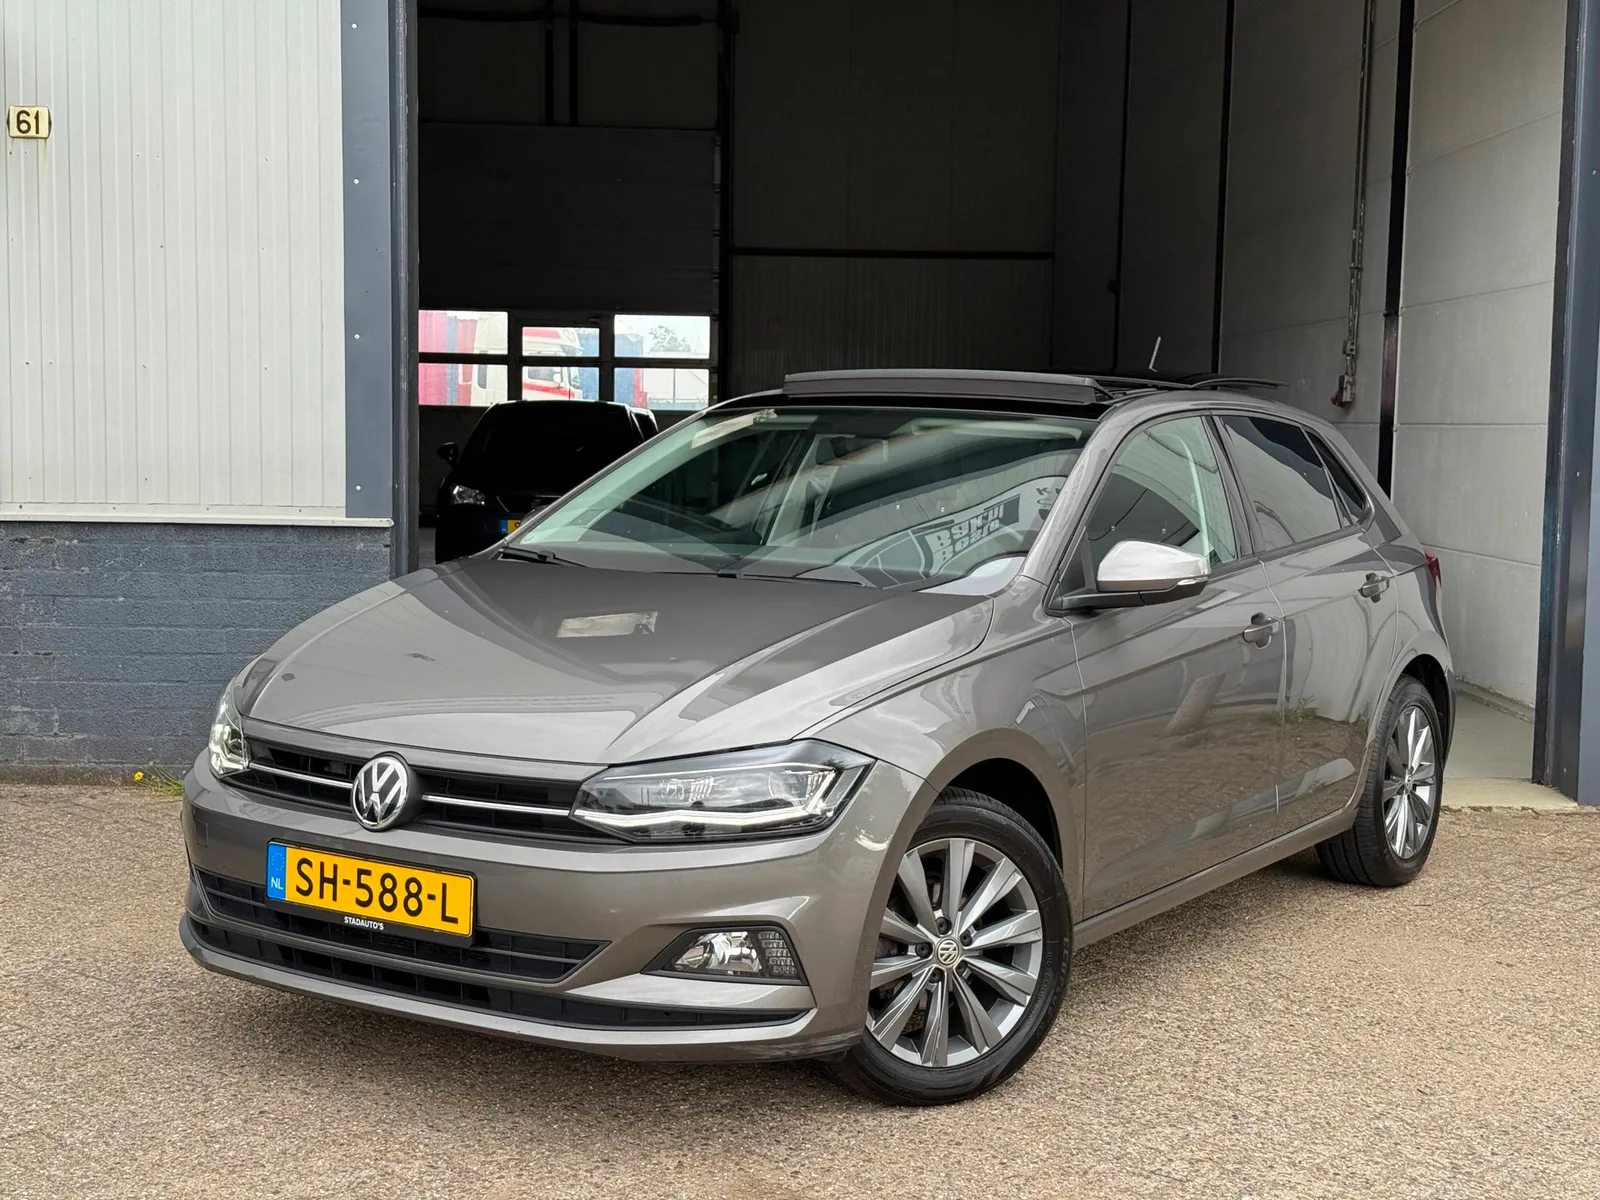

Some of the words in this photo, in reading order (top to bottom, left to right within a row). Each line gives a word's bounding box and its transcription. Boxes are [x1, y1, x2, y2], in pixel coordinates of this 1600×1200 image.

[16, 109, 39, 135] 61
[270, 876, 284, 891] NL
[295, 857, 459, 925] SH-588-L
[343, 915, 385, 931] STADAUTO'S
